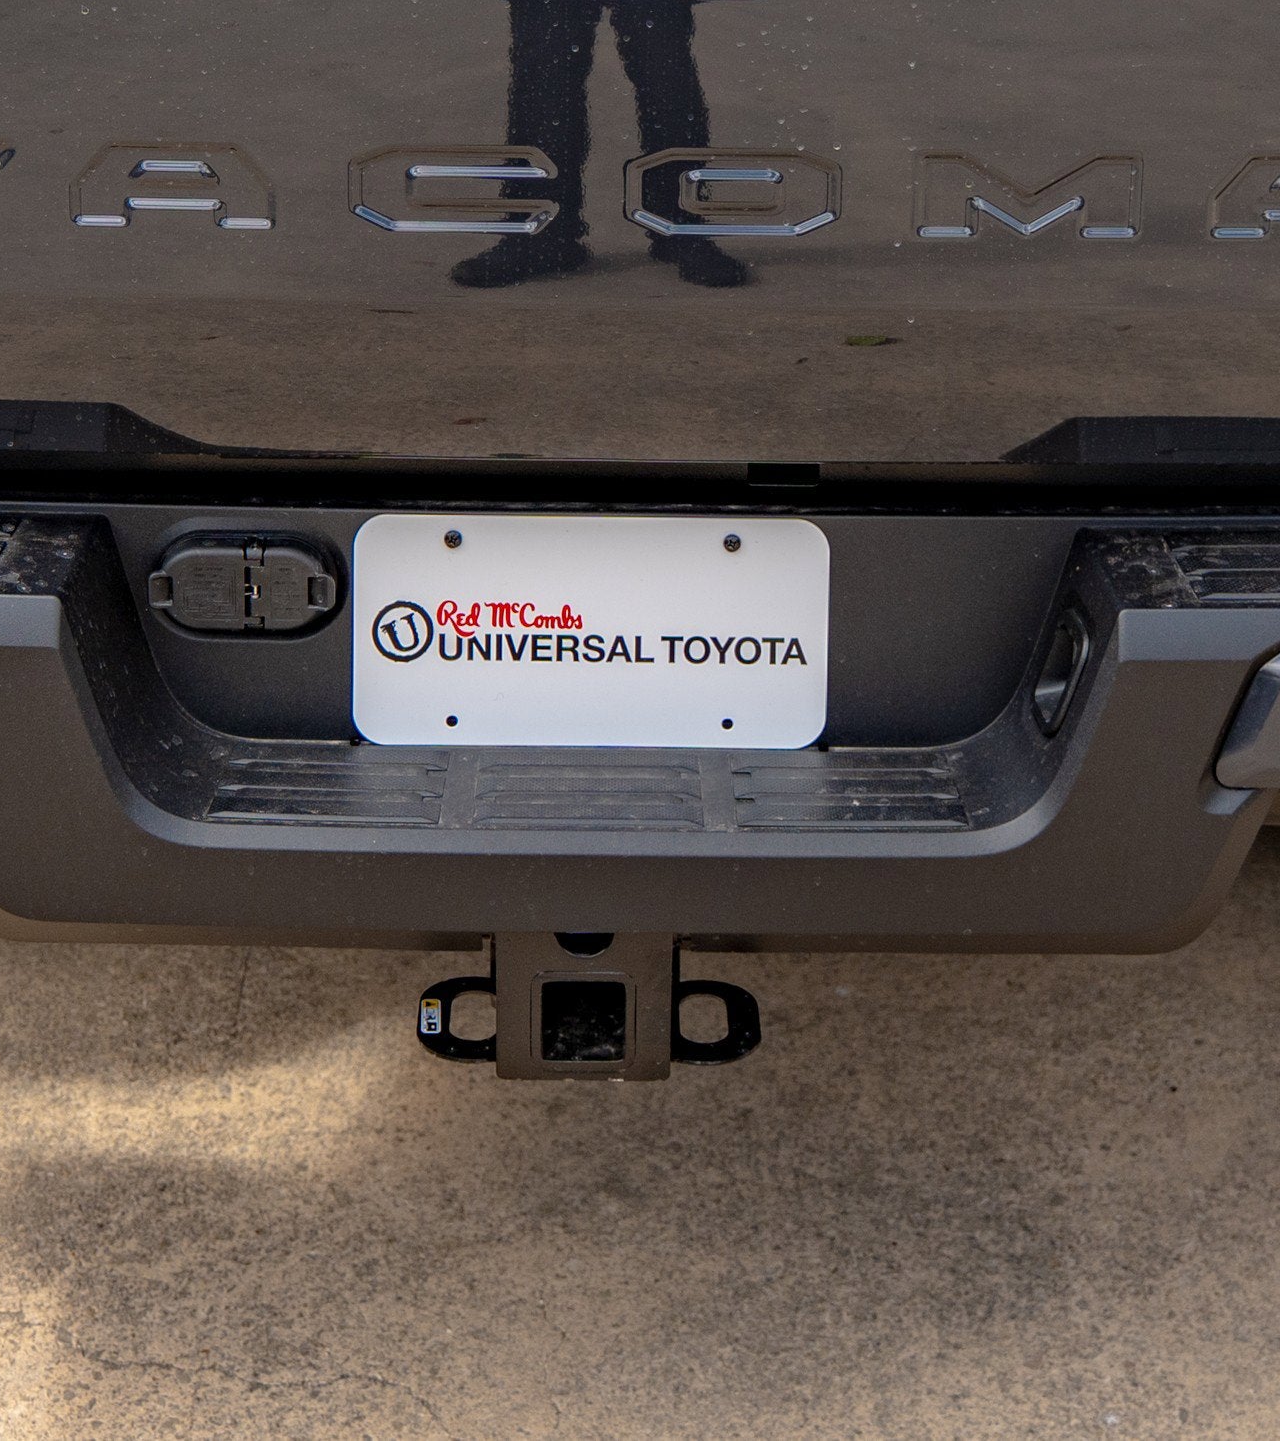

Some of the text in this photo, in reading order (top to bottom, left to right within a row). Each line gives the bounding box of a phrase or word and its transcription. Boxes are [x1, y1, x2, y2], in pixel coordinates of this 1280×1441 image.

[436, 600, 583, 637] Red McCombs
[438, 633, 808, 665] UNIVERSAL TOYOTA
